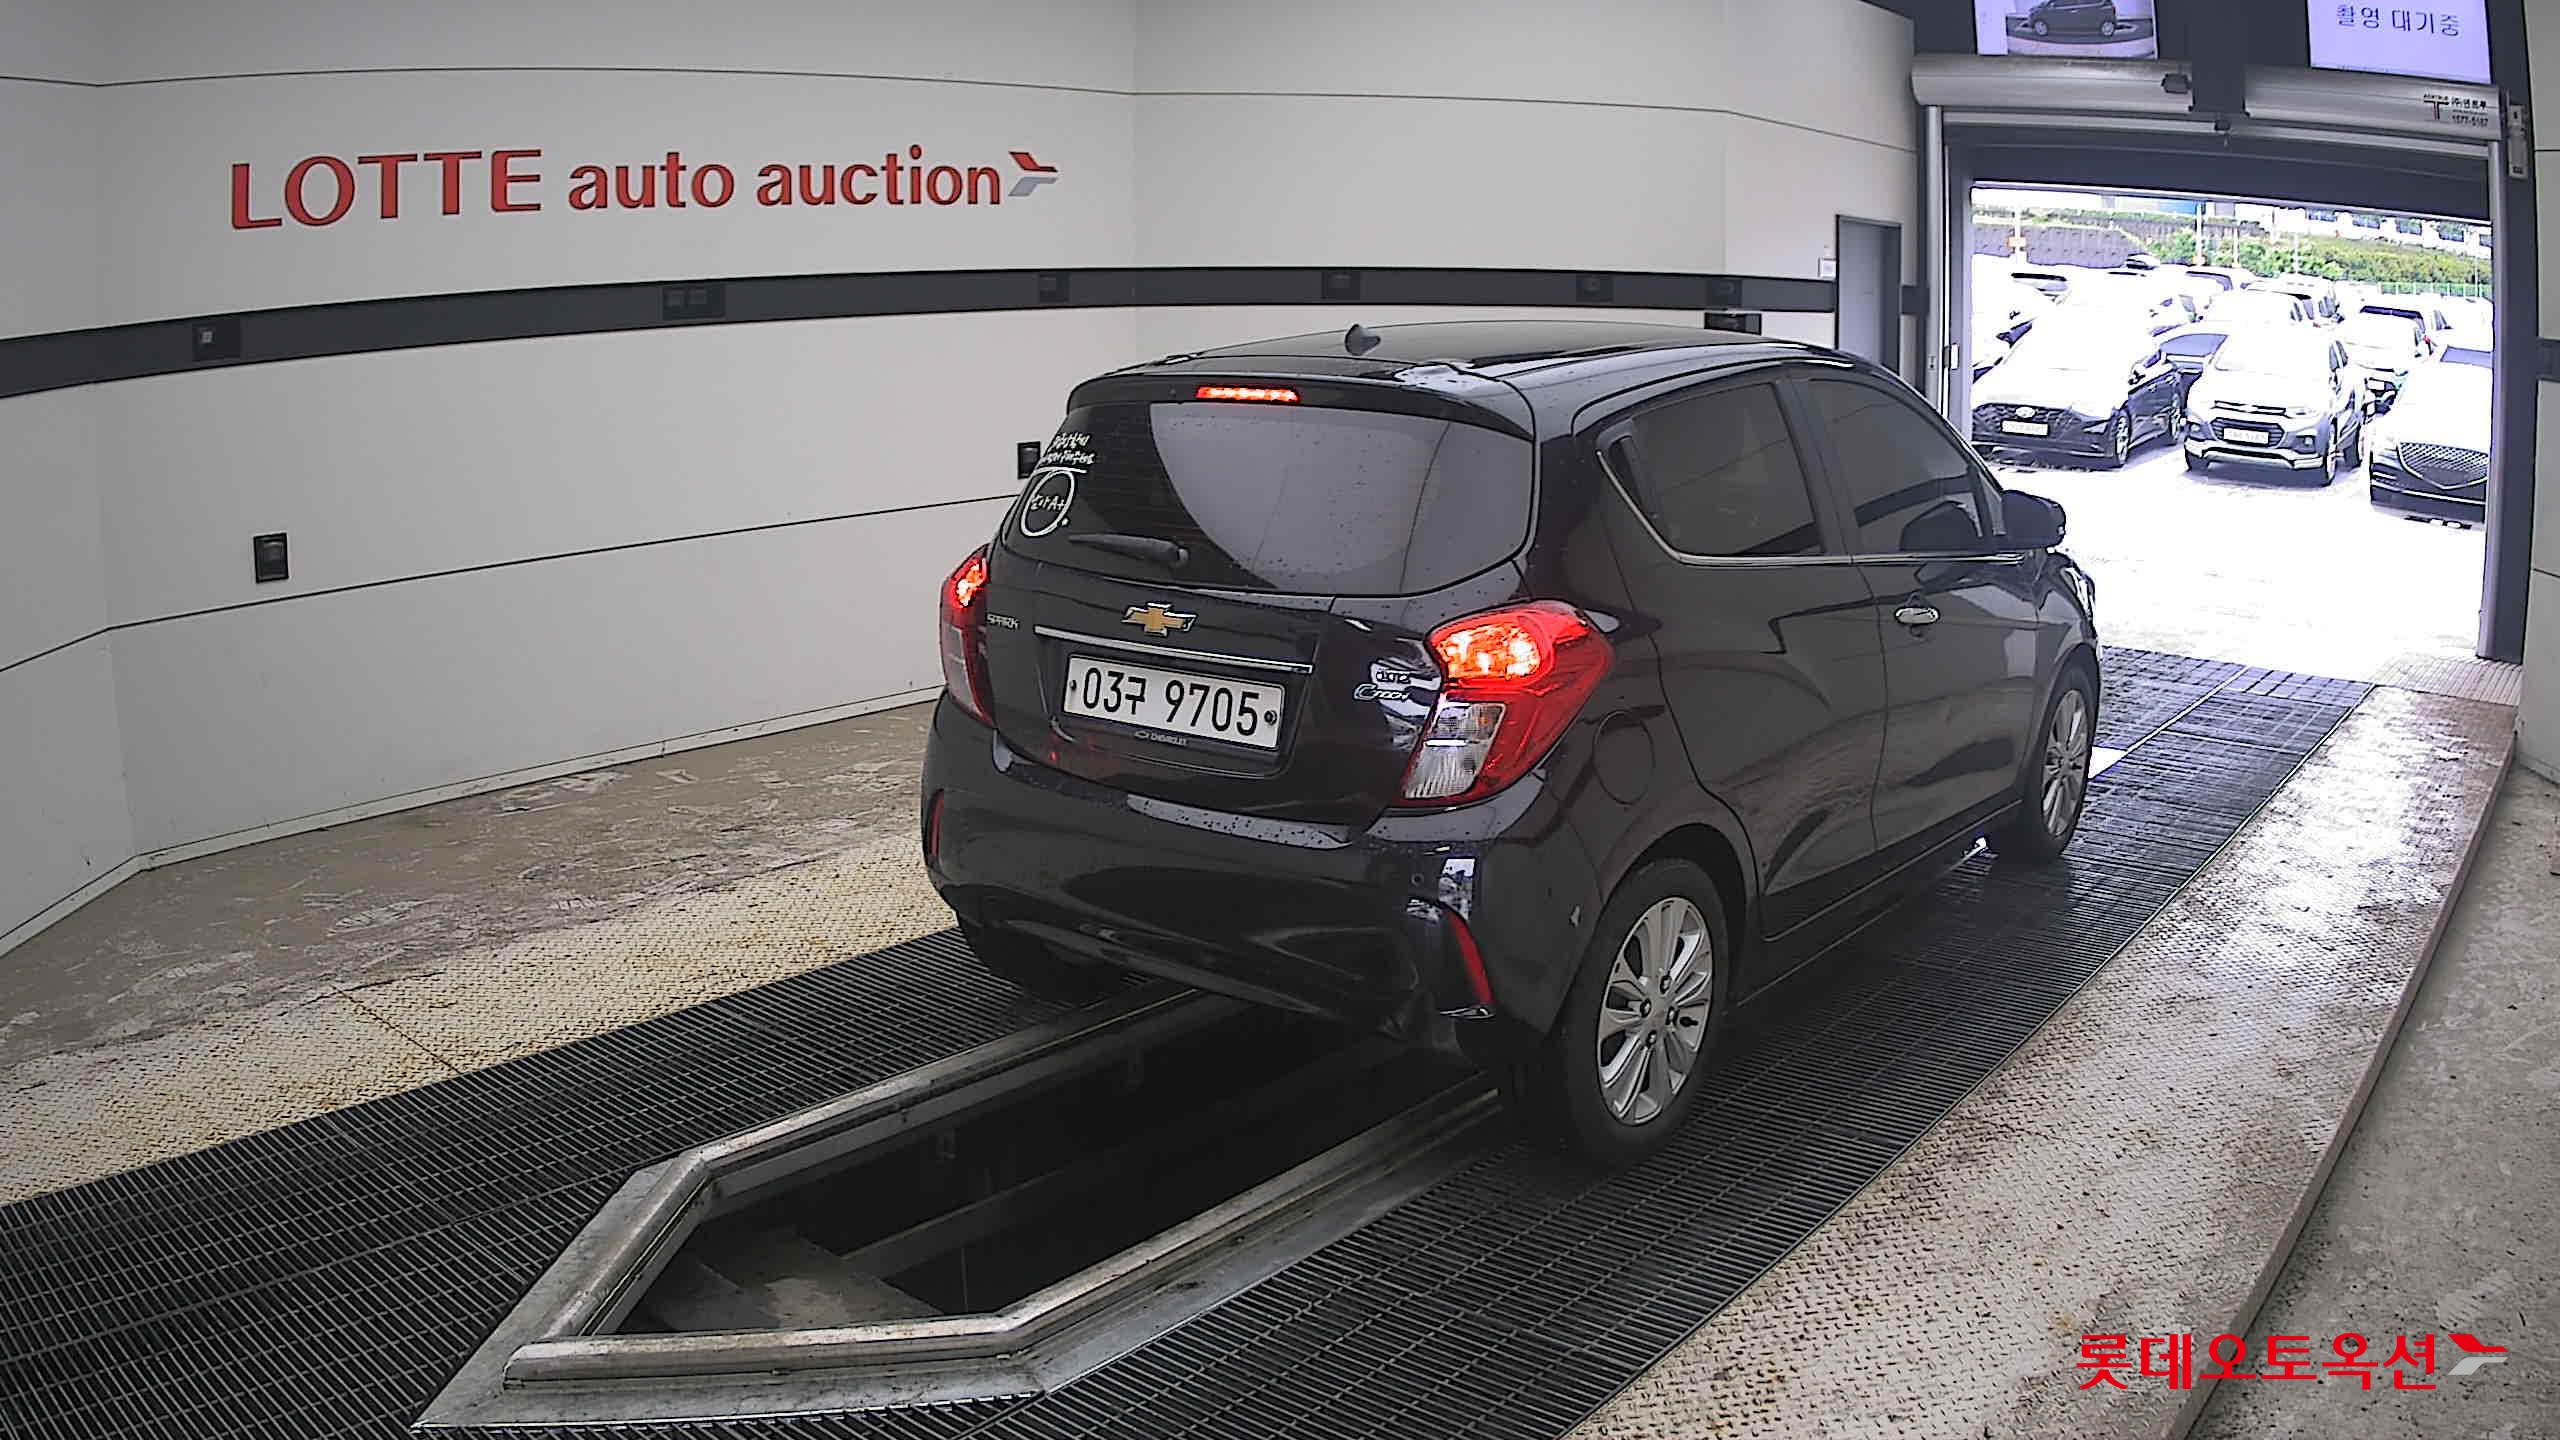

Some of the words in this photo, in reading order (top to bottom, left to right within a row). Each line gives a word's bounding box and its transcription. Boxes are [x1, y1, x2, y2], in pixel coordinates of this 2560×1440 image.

[2337, 4, 2380, 29] 촬영
[2391, 9, 2459, 37] 대기중
[230, 149, 541, 231] LOTTE
[568, 151, 735, 209] auto
[756, 144, 1002, 206] auction
[1082, 667, 1147, 715] 03구
[1165, 679, 1259, 737] 9705
